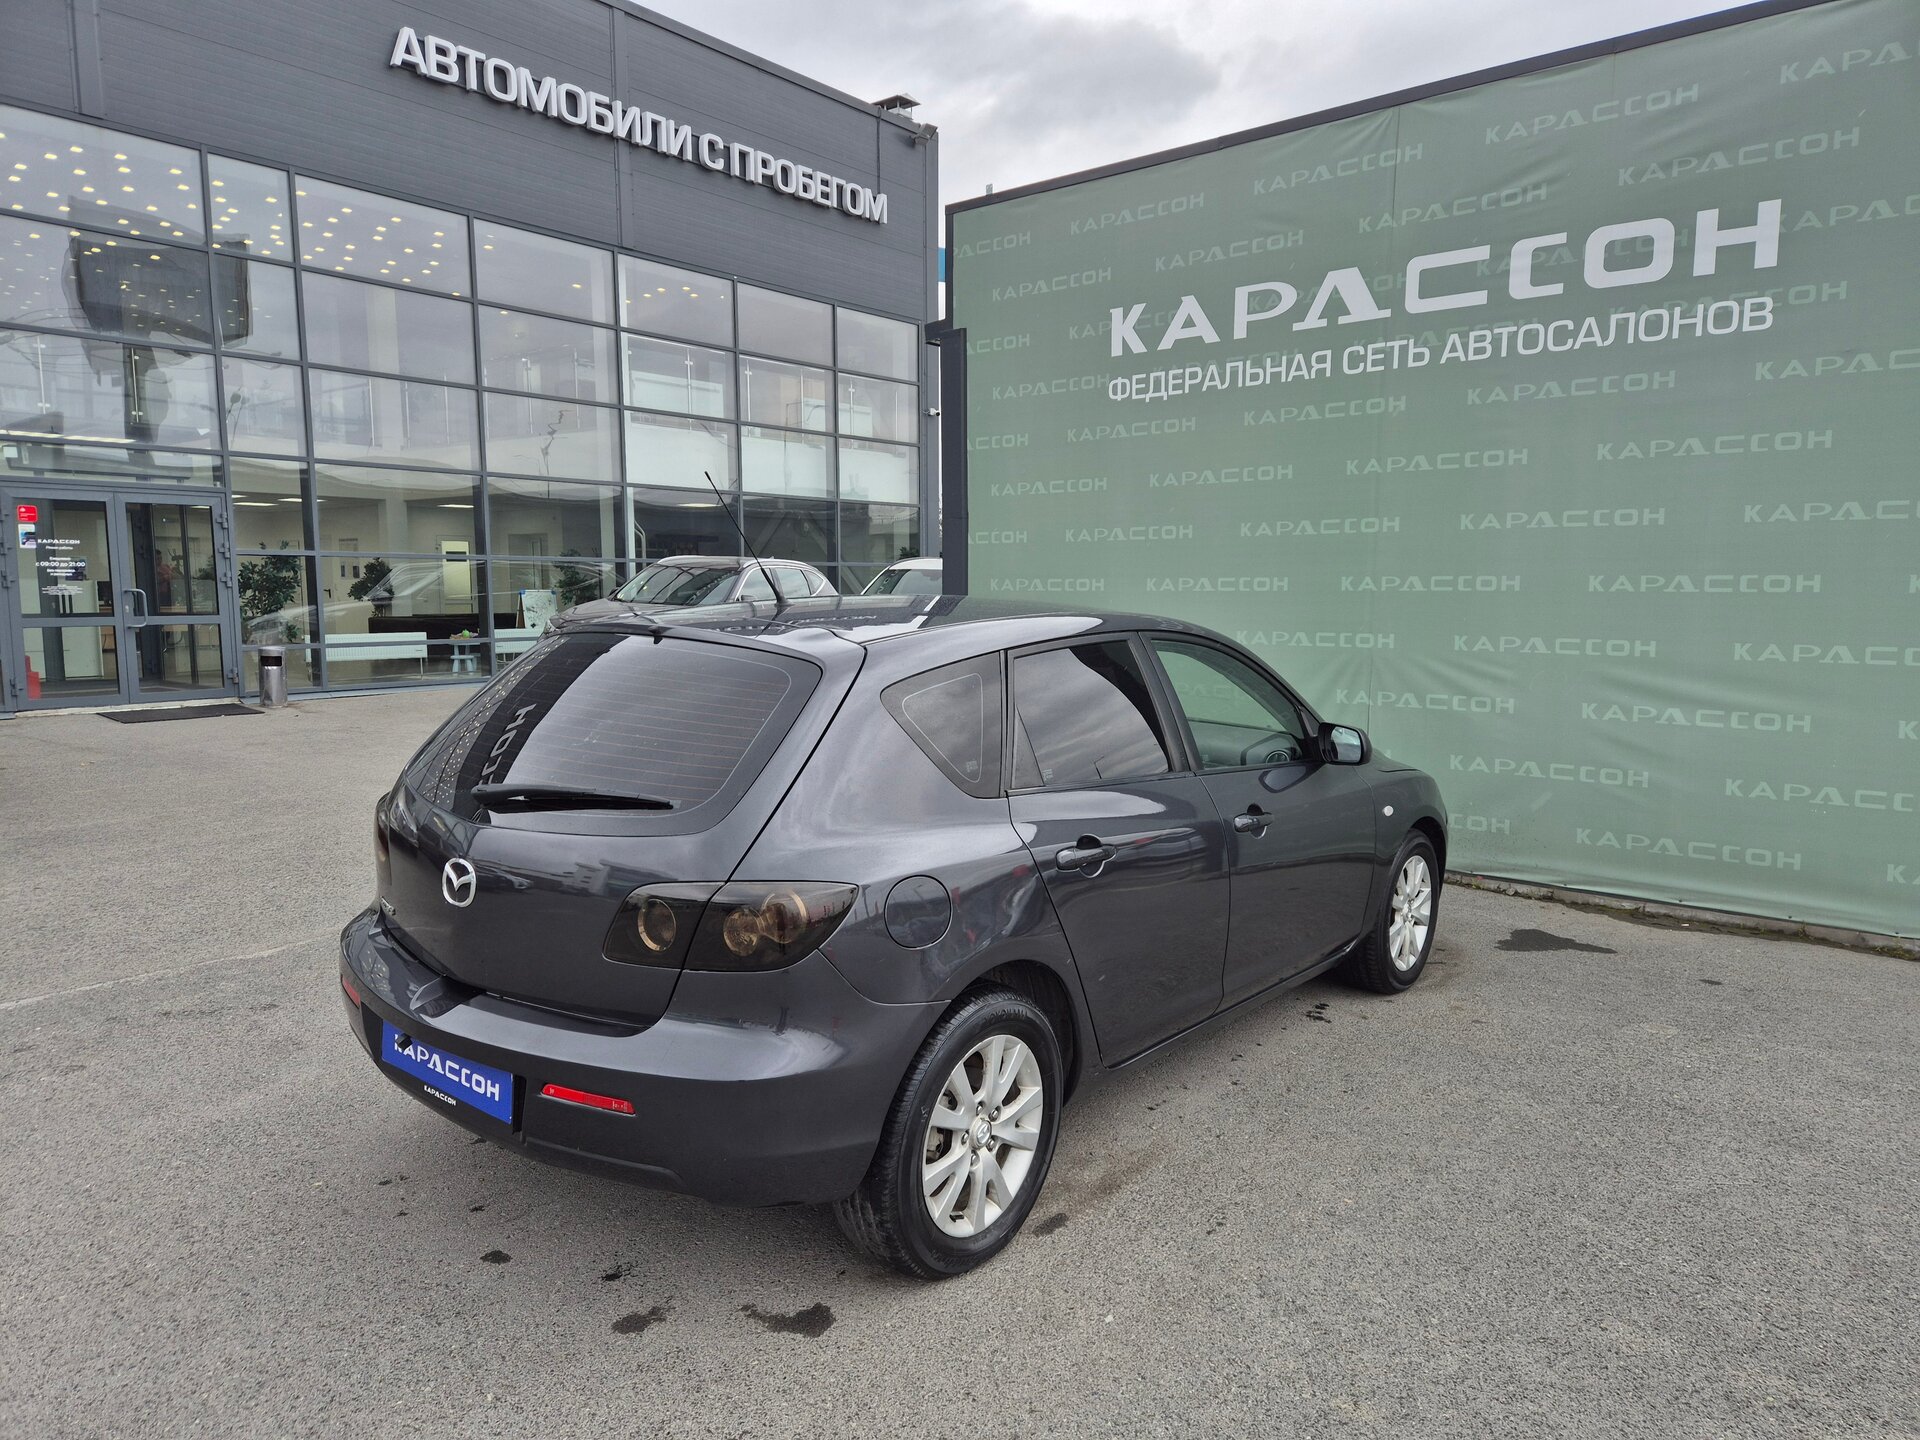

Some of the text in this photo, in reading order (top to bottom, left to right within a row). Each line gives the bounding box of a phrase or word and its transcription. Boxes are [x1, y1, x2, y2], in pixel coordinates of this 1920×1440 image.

[1780, 38, 1920, 84] КАРА
[390, 26, 888, 225] АВТОМОБИЛИ С ПРОБЕГОМ
[1485, 83, 1700, 145] КАРАССОН
[1254, 143, 1423, 195] КАРАССОН
[1618, 127, 1861, 187] КАРАССОН
[1070, 192, 1204, 237] КАРАССОН
[1358, 183, 1547, 234] КАРАССОН
[1155, 230, 1304, 272] КАРАССОН
[992, 267, 1112, 301] КАРАССОН
[1110, 199, 1782, 357] КАРАССОН
[1108, 296, 1774, 402] ФЕДЕРАЛЬНАЯ СЕТЬ АВТОСАЛОНОВ
[993, 373, 1110, 400] КАРАССОН
[1467, 370, 1676, 405] КАРАССОН
[1244, 396, 1406, 427] КАРАССОН
[1067, 416, 1196, 443] КАРАССОН
[1597, 430, 1834, 460] КАРАССОН
[1149, 464, 1293, 488] КАРАССОН
[1346, 448, 1529, 475] КАРАССОН
[991, 477, 1108, 496] КАРАССОН
[1240, 516, 1400, 537] КАРАССОН
[1460, 508, 1666, 530] КАРАССОН
[1744, 500, 1920, 523] КАРАС
[1065, 524, 1193, 543] КАРАССОН
[990, 578, 1105, 592] КАРАССОН
[1146, 576, 1289, 592] КАРАССОН
[1340, 575, 1521, 592] КАРАССОН
[1588, 574, 1821, 593] КАРАССОН
[1454, 634, 1657, 658] КАРАССОН
[1336, 688, 1515, 714] КАРАССОН
[1581, 702, 1812, 733] КАРАССОН
[1449, 754, 1649, 788] КАРАССОН
[1576, 827, 1801, 870] КАРАССОН
